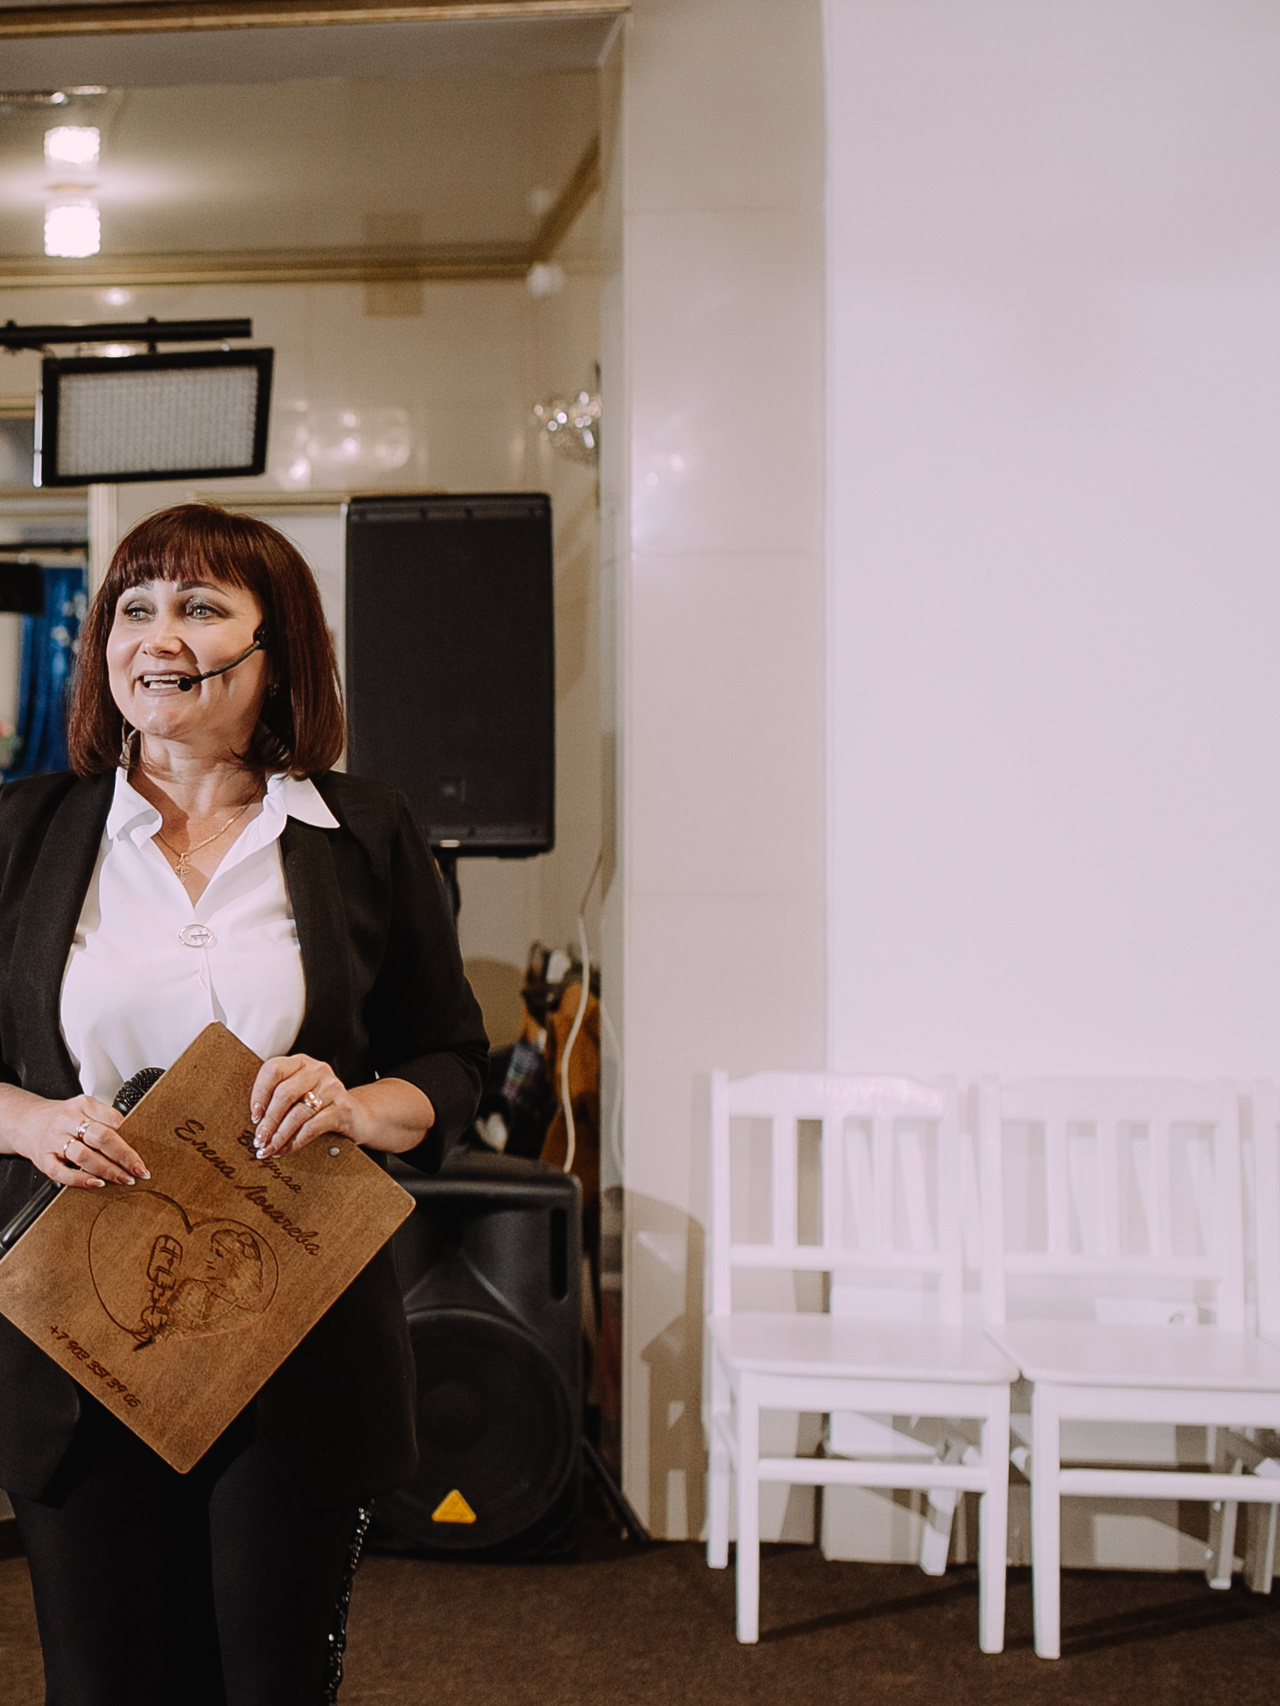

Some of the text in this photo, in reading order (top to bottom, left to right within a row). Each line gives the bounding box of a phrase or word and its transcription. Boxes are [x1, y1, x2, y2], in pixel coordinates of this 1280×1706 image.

[174, 1119, 235, 1179] Елена
[50, 1325, 69, 1340] +7
[66, 1340, 90, 1361] 903
[106, 1378, 128, 1393] 39
